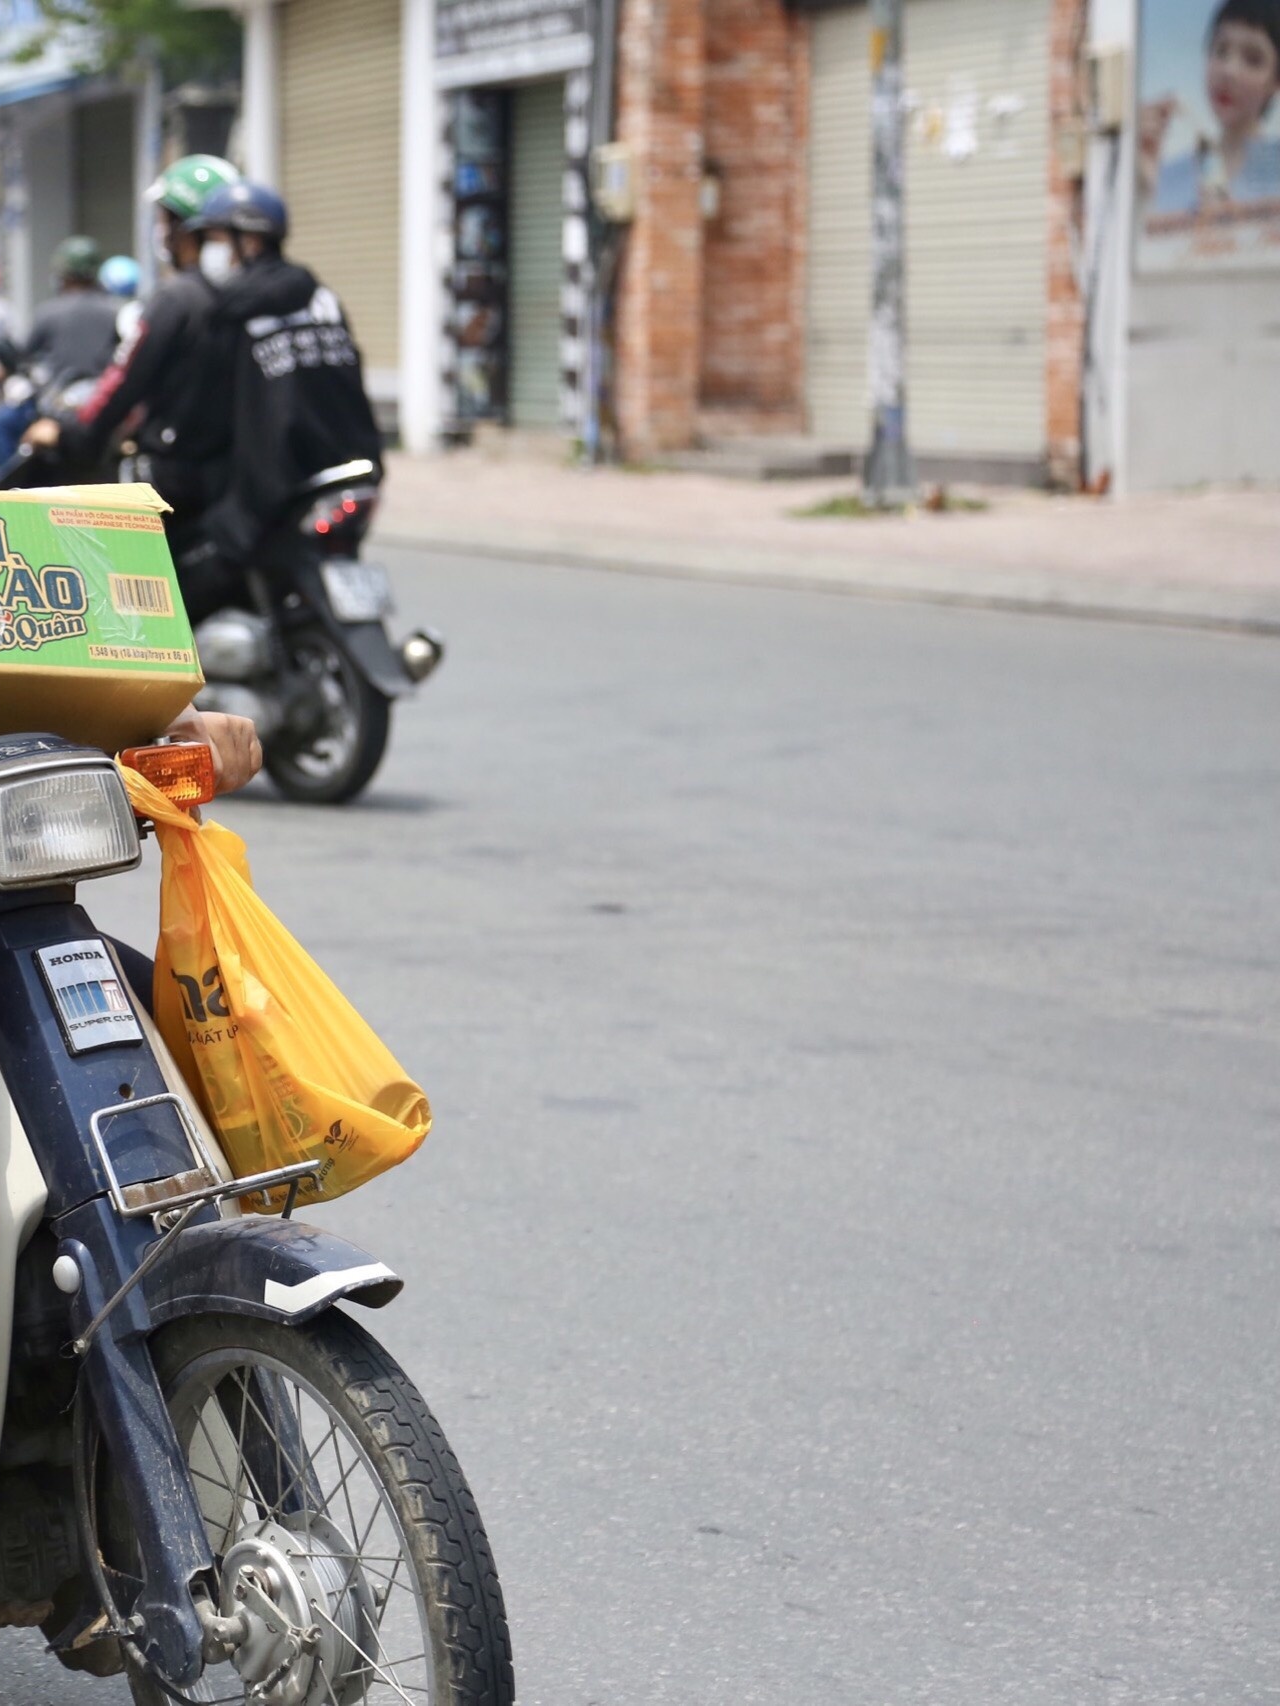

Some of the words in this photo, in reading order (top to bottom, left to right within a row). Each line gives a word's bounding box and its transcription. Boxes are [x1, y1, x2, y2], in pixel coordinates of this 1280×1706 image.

[49, 951, 104, 966] HONDA
[69, 1016, 112, 1031] SUPER
[113, 1014, 135, 1022] CUB
